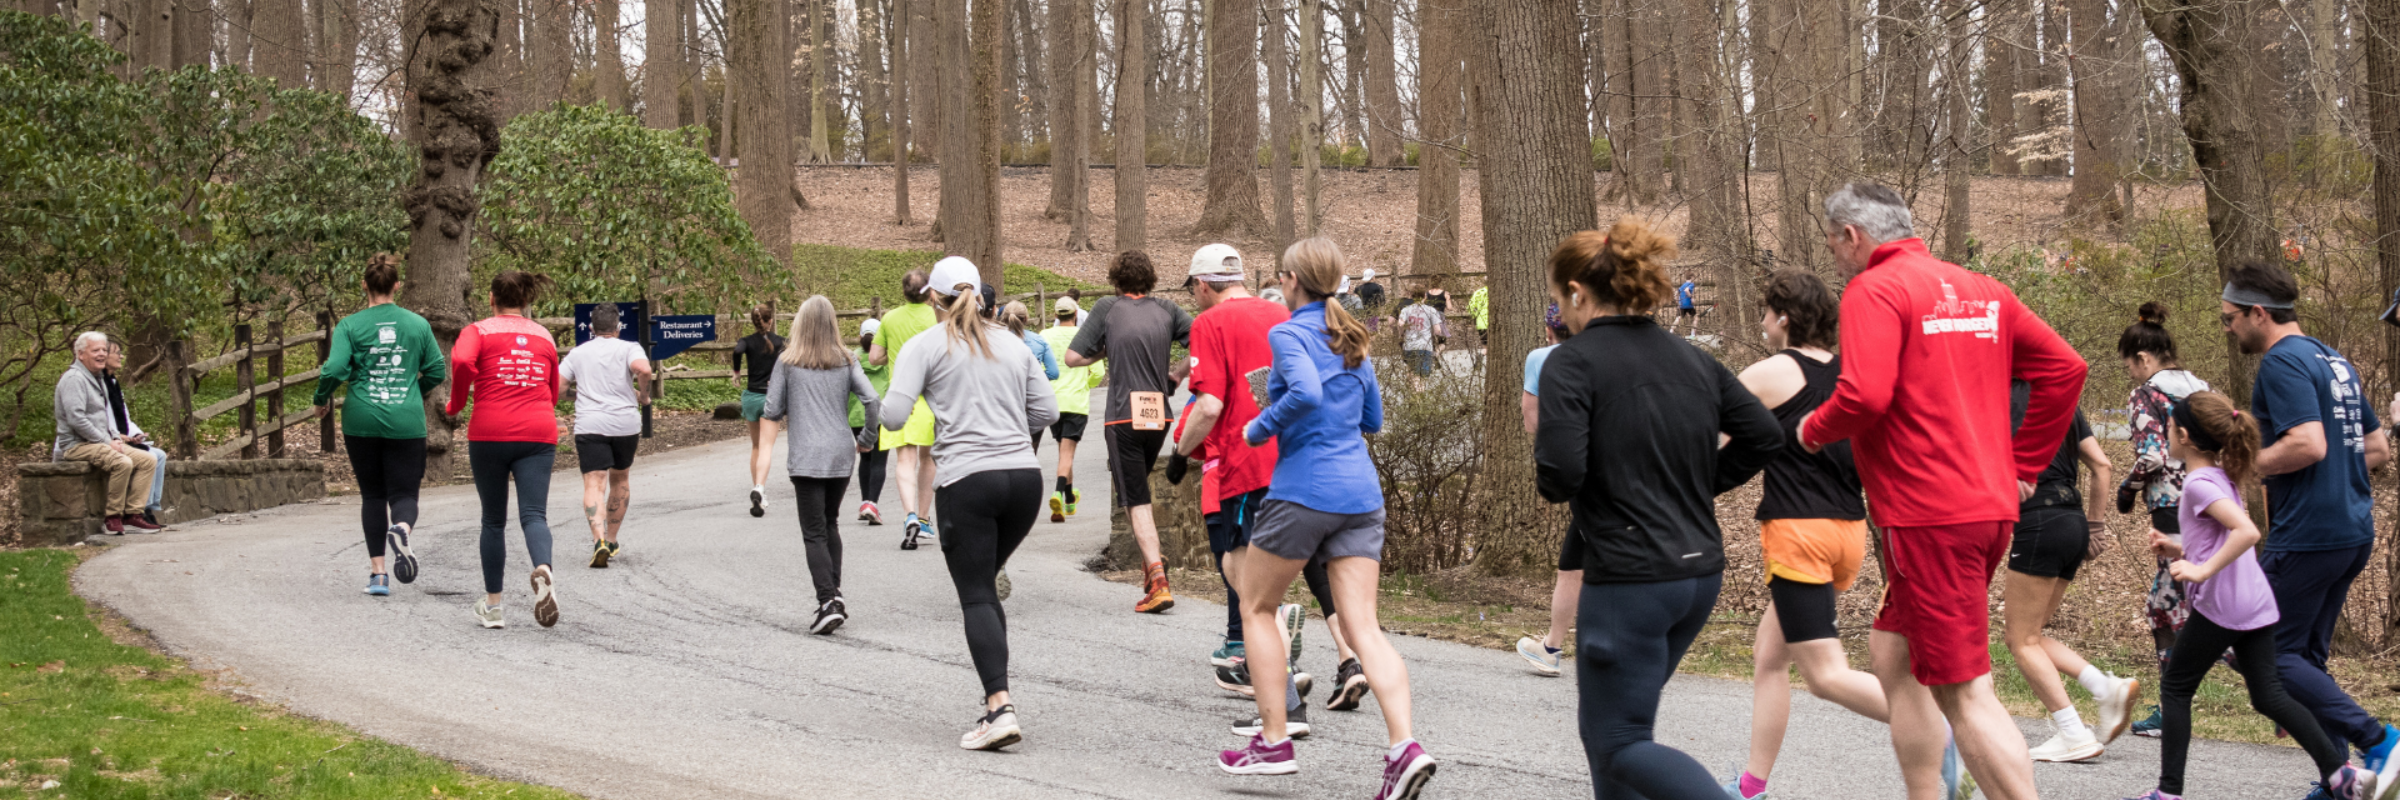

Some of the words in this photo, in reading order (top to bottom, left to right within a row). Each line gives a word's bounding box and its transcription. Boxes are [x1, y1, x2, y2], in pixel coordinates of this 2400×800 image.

[660, 320, 702, 329] Restaurant
[663, 330, 704, 339] Deliveries
[1139, 408, 1159, 419] 4623
